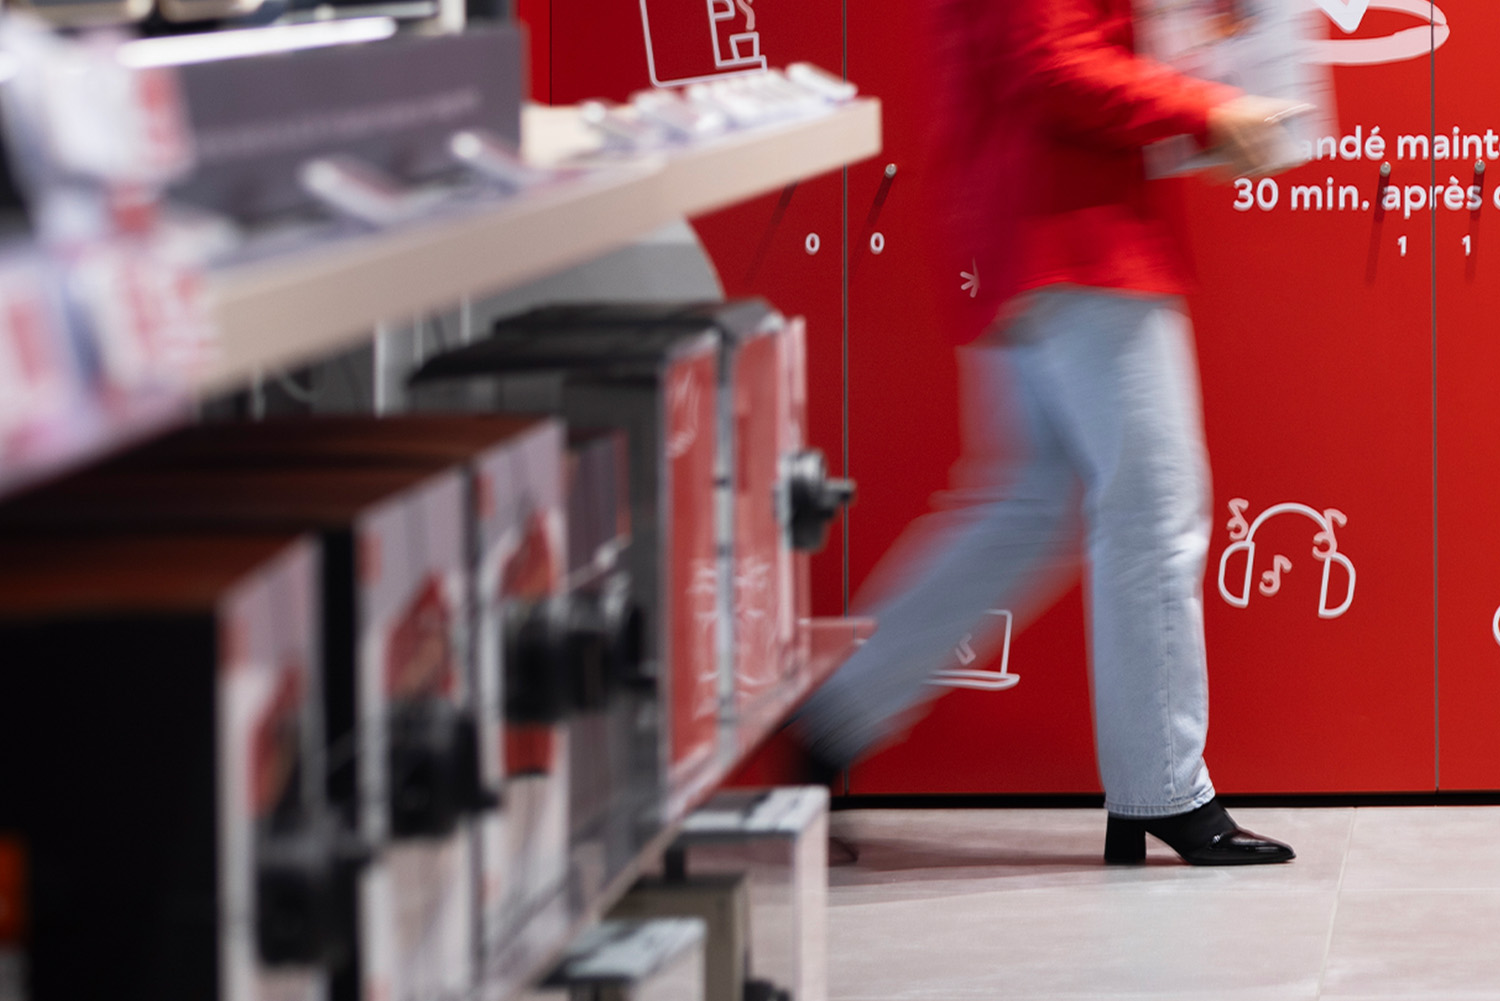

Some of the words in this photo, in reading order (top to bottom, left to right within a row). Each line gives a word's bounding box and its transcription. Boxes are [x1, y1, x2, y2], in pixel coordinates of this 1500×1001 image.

[1302, 126, 1386, 161] andé
[1233, 177, 1279, 211] 30
[1290, 177, 1370, 211] min.
[1382, 176, 1483, 219] après
[805, 232, 821, 255] 0
[870, 232, 885, 255] 0
[1397, 235, 1408, 256] 1
[1461, 234, 1472, 256] 1
